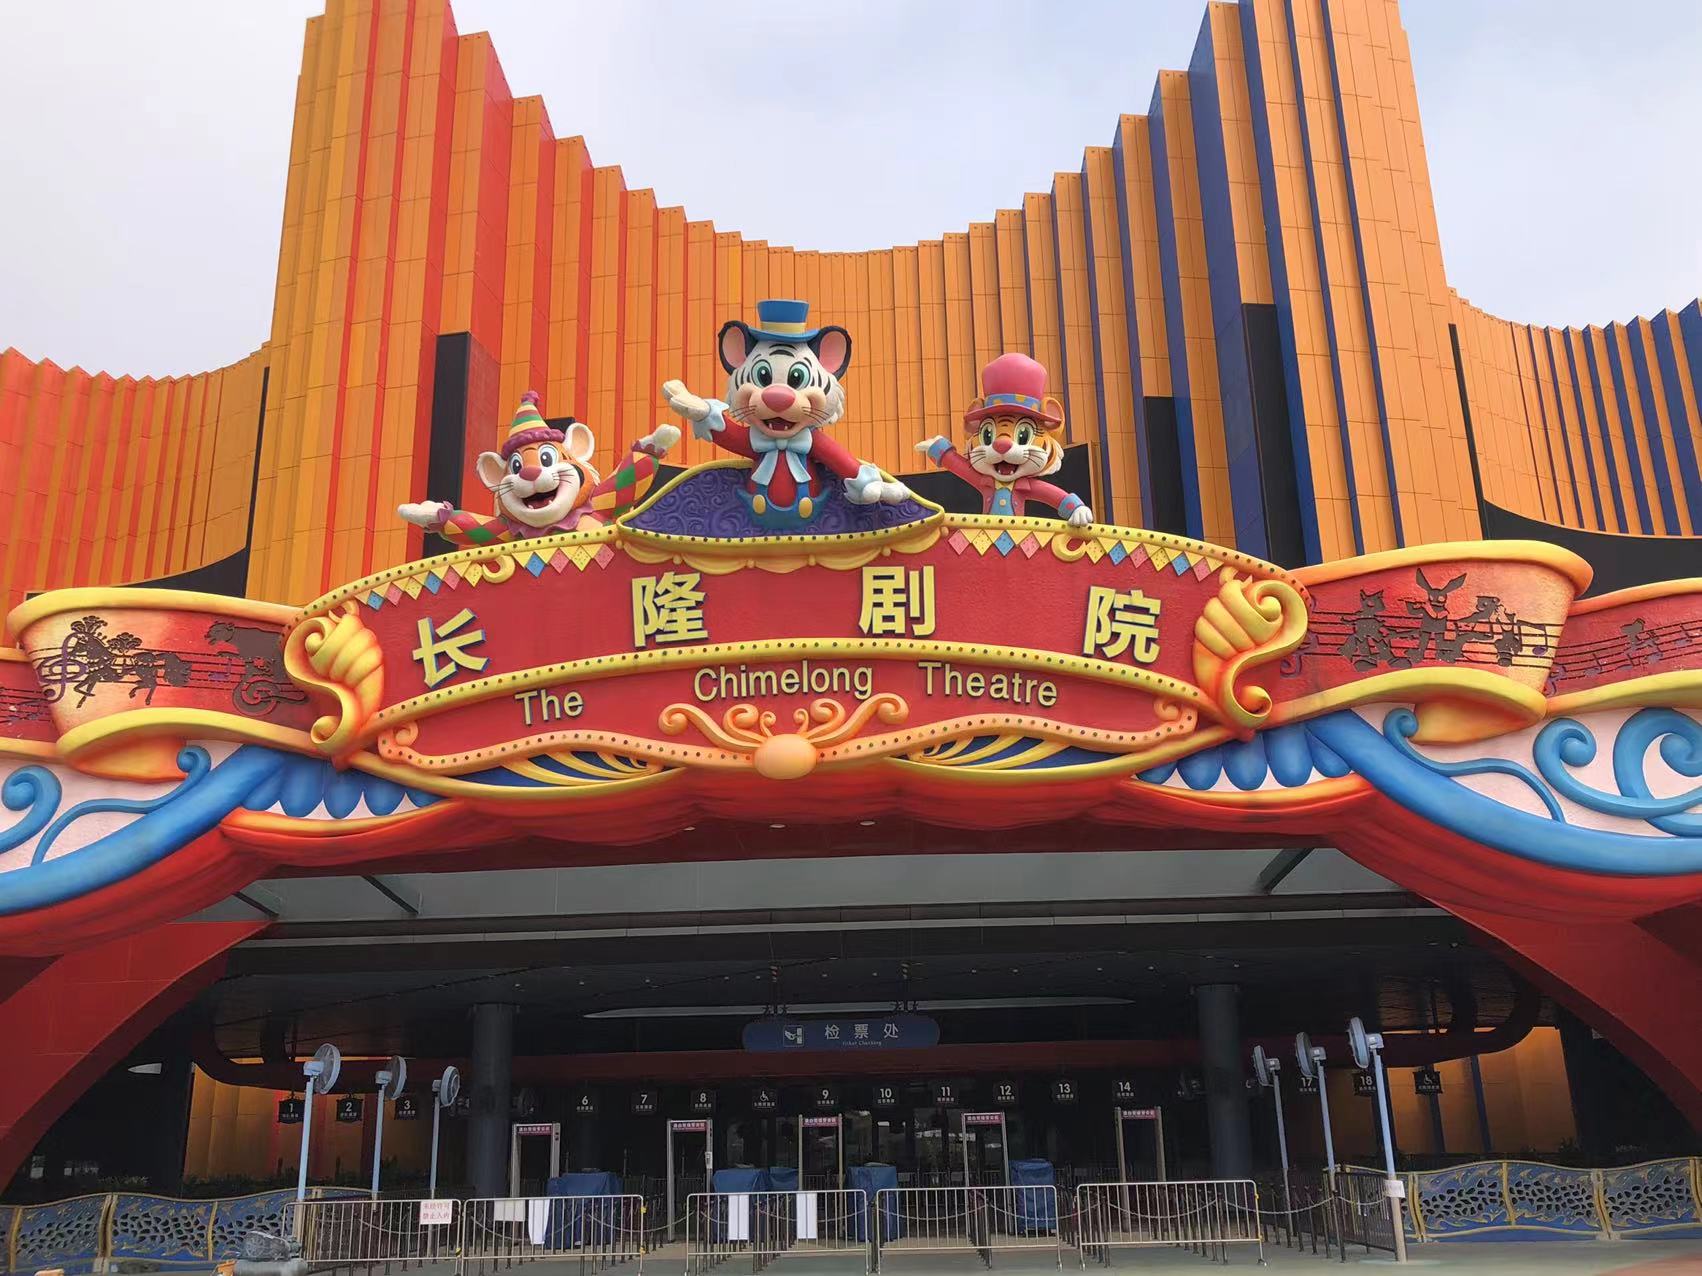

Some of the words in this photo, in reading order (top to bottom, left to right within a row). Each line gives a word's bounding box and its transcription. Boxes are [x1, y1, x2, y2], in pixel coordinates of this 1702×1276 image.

[412, 565, 1162, 688] 长隆剧院
[515, 689, 584, 725] The
[694, 660, 873, 701] Chimelong
[918, 661, 1058, 707] Theatre
[824, 1023, 899, 1040] 检票处
[1301, 1077, 1312, 1087] 17
[1360, 1076, 1373, 1085] 18
[941, 1086, 951, 1096] 11
[999, 1085, 1012, 1095] 12
[1058, 1083, 1071, 1093] 13
[1118, 1082, 1131, 1091] 14
[699, 1092, 707, 1103] 8
[822, 1089, 829, 1099] 9
[880, 1088, 892, 1098] 10
[581, 1095, 588, 1105] 6
[640, 1094, 648, 1104] 7
[289, 1103, 294, 1112] 1
[345, 1102, 352, 1112] 2
[404, 1100, 411, 1110] 3
